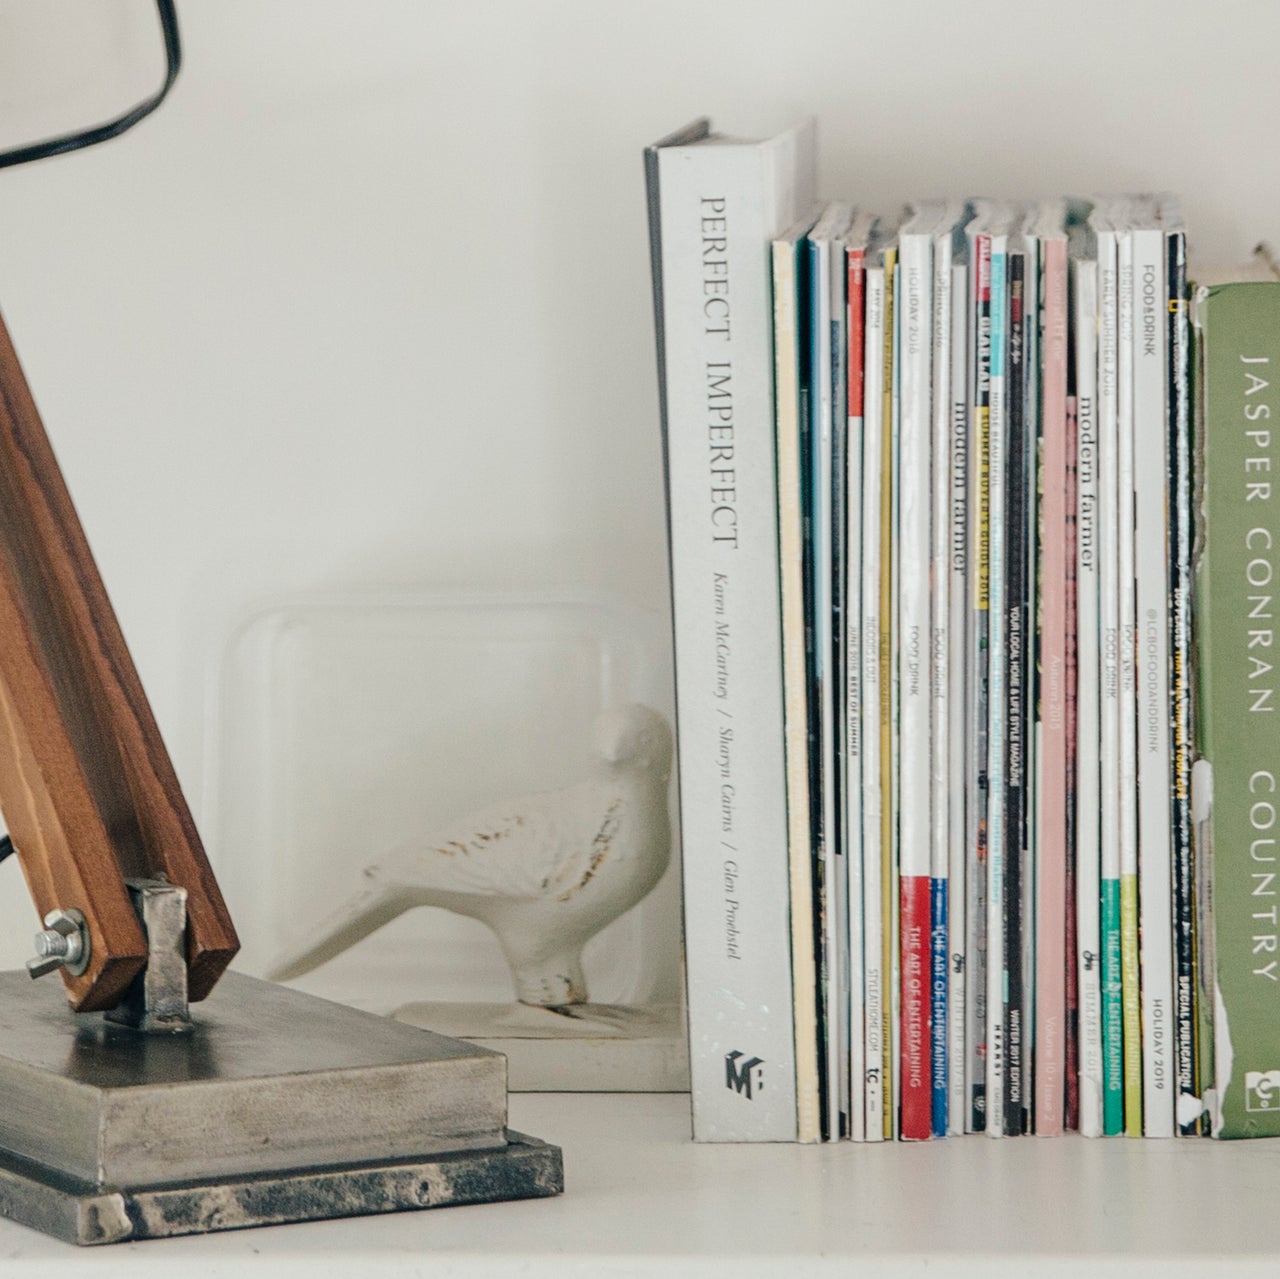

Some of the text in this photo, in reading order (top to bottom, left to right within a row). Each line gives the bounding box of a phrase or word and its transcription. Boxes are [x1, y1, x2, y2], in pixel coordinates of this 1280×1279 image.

[908, 267, 921, 322] HOLIDAY
[700, 196, 739, 549] PERFECT IMPERFECT
[991, 392, 1000, 487] HOUSE BEAUTIFUL
[1079, 397, 1096, 573] modern farmer
[712, 572, 728, 615] Karen
[849, 626, 858, 648] JUNE
[1009, 607, 1020, 631] YOUR
[712, 619, 730, 700] McCartney
[909, 625, 921, 697] FOOD DRINK
[1009, 632, 1020, 660] LOCAL
[1104, 628, 1116, 660] FOOD
[849, 676, 858, 699] BEST
[1009, 661, 1020, 687] HOME
[1049, 655, 1062, 702] Autumn
[1146, 609, 1159, 754] @LCBOFOODANDDRINK
[1239, 355, 1278, 982] JASPER CONRAN COUNTRY
[849, 701, 858, 713] OF
[1009, 697, 1020, 714] LIFE
[1009, 716, 1020, 742] STYLE
[715, 725, 734, 778] Sharyn
[850, 715, 859, 757] SUMMER
[1009, 743, 1020, 787] MAGAZINE
[720, 783, 735, 832] Cairns
[723, 859, 738, 893] Glen
[725, 898, 742, 960] Proebstel
[933, 955, 945, 977] ART
[933, 981, 945, 997] OF
[868, 968, 879, 1052] STYLEATHOME.COM
[909, 926, 921, 1088] THE ART OF ENTERTAINING
[1084, 982, 1097, 1046] SUMMER
[1108, 929, 1120, 1091] THE ART OF ENTERTAINING
[1180, 976, 1191, 1019] SPECIAL
[933, 1001, 945, 1089] ENTERTAINING
[1009, 1009, 1020, 1102] WINTER 2017 EDITION
[1046, 1016, 1058, 1058] Volume
[1152, 999, 1164, 1090] HOLIDAY 2019
[1181, 1020, 1192, 1088] PUBLICATION
[867, 1067, 880, 1084] tc
[1046, 1062, 1058, 1074] 10
